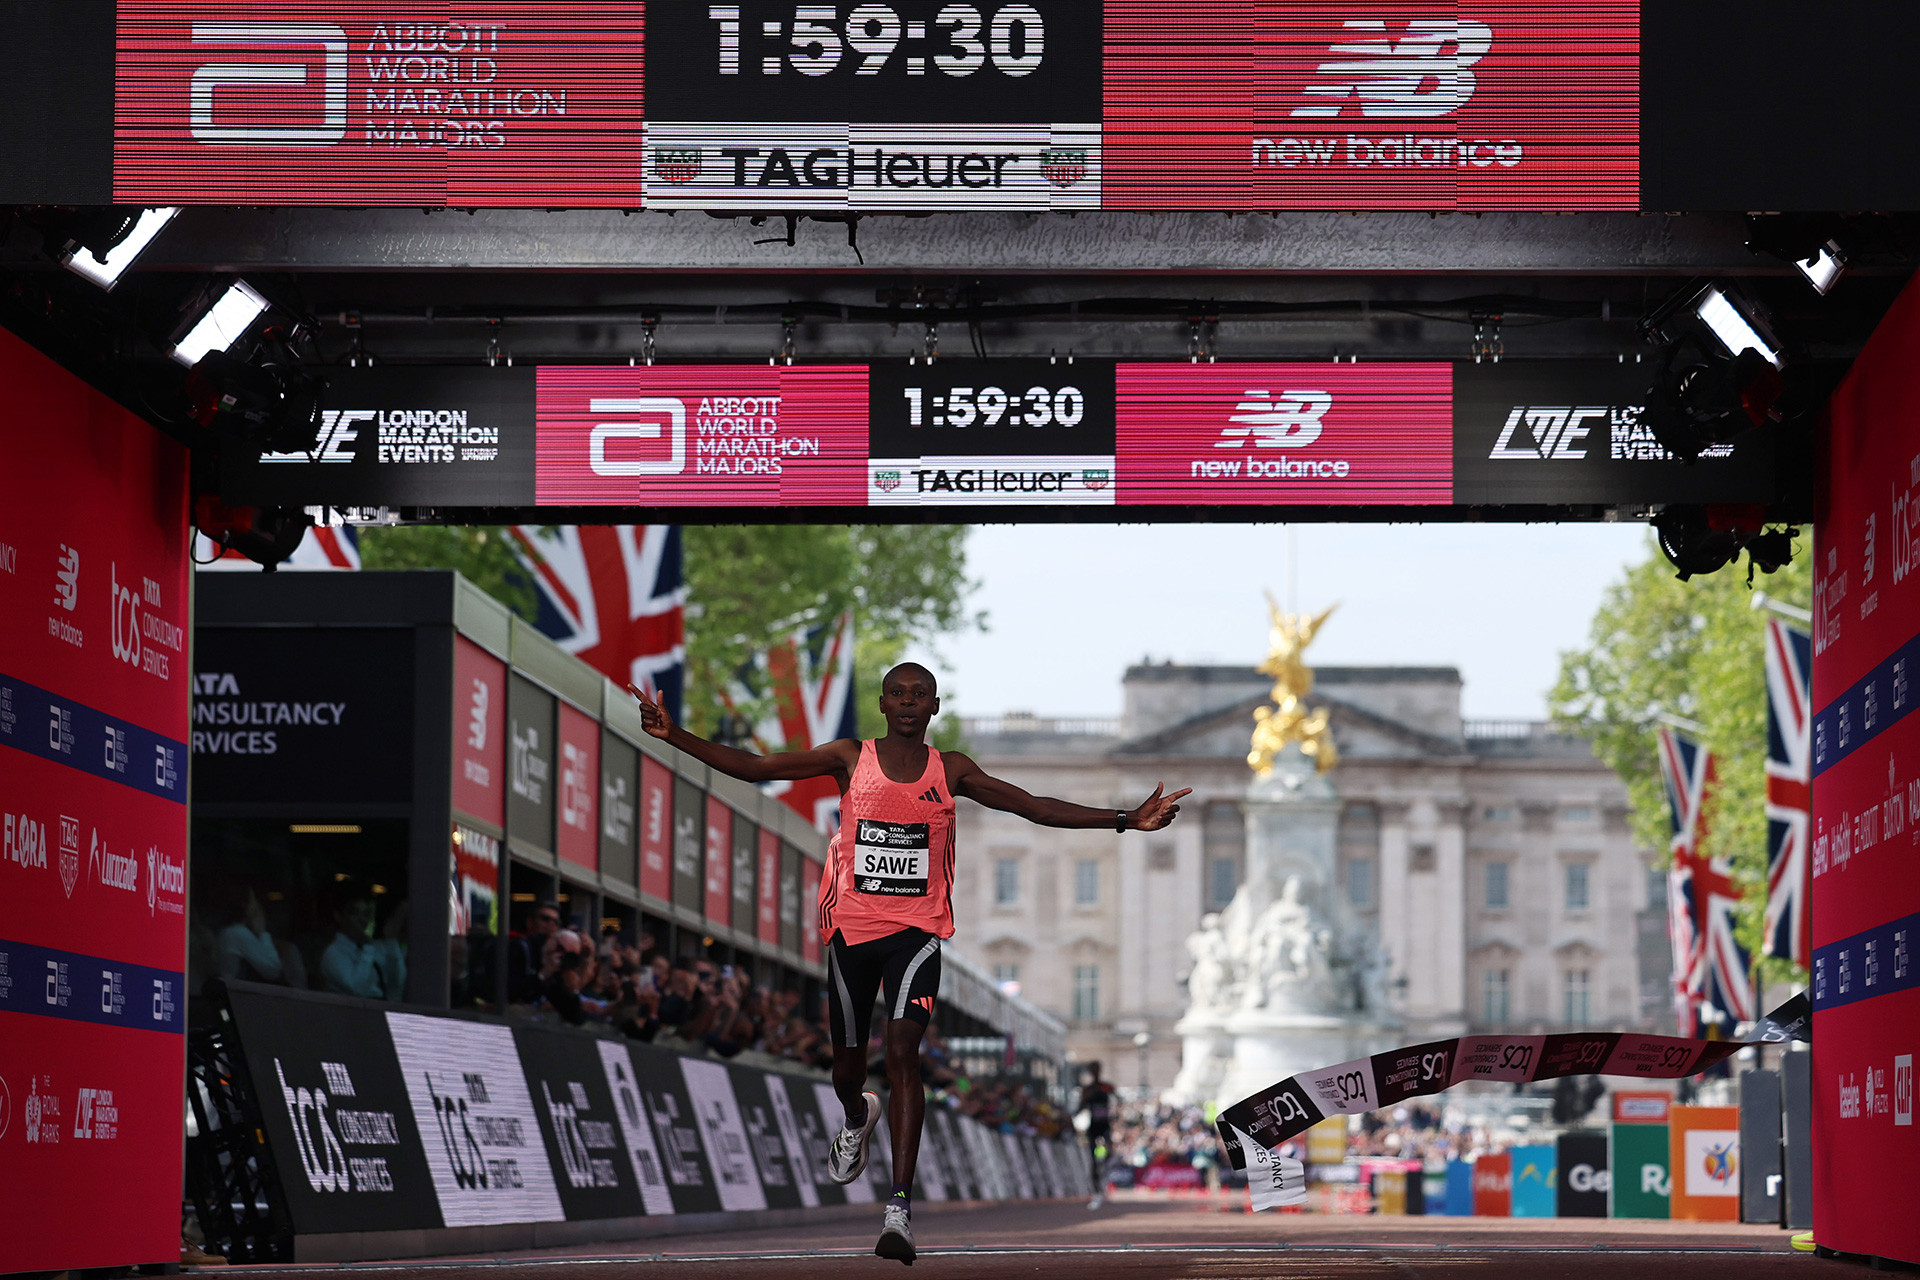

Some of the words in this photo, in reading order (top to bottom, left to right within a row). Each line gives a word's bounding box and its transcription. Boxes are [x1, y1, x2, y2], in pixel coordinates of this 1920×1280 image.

[367, 23, 507, 52] ABBOTT
[708, 4, 1045, 77] 1:59:30
[365, 57, 498, 83] WORLD
[365, 89, 566, 115] MARATHON
[365, 121, 507, 149] MAJORS
[1252, 138, 1337, 167] new
[1347, 134, 1523, 167] balance
[378, 410, 467, 427] LONDON
[697, 397, 783, 416] ABBOTT
[904, 386, 1084, 428] 1:59:30
[378, 427, 498, 444] MARATHON
[696, 418, 777, 436] WORLD
[378, 445, 455, 463] EVENTS
[697, 437, 819, 456] MARATHON
[697, 457, 783, 475] MAJORS
[1191, 460, 1242, 478] new
[1247, 456, 1350, 478] balance
[143, 576, 161, 608] TATA
[112, 561, 140, 667] tcs
[143, 612, 183, 652] CONSULTANCY
[143, 647, 169, 680] SERVICES
[193, 702, 346, 725] NSULTANCY
[192, 731, 277, 754] RVICES
[4, 813, 47, 869] FLORA
[61, 821, 77, 848] TAG
[860, 823, 888, 843] tcs
[102, 841, 138, 892] Lucozade
[864, 854, 919, 875] SAWE
[895, 885, 920, 894] balance
[1396, 1055, 1419, 1070] SERVICES
[1422, 1051, 1449, 1083] tcs
[1473, 1065, 1493, 1073] TATA
[1499, 1045, 1533, 1076] tcs
[1659, 1047, 1691, 1072] tcs
[1337, 1071, 1368, 1103] tcs
[1403, 1080, 1418, 1092] TATA
[1267, 1091, 1309, 1126] tcs
[274, 1057, 350, 1193] tcs
[425, 1071, 488, 1190] tcs
